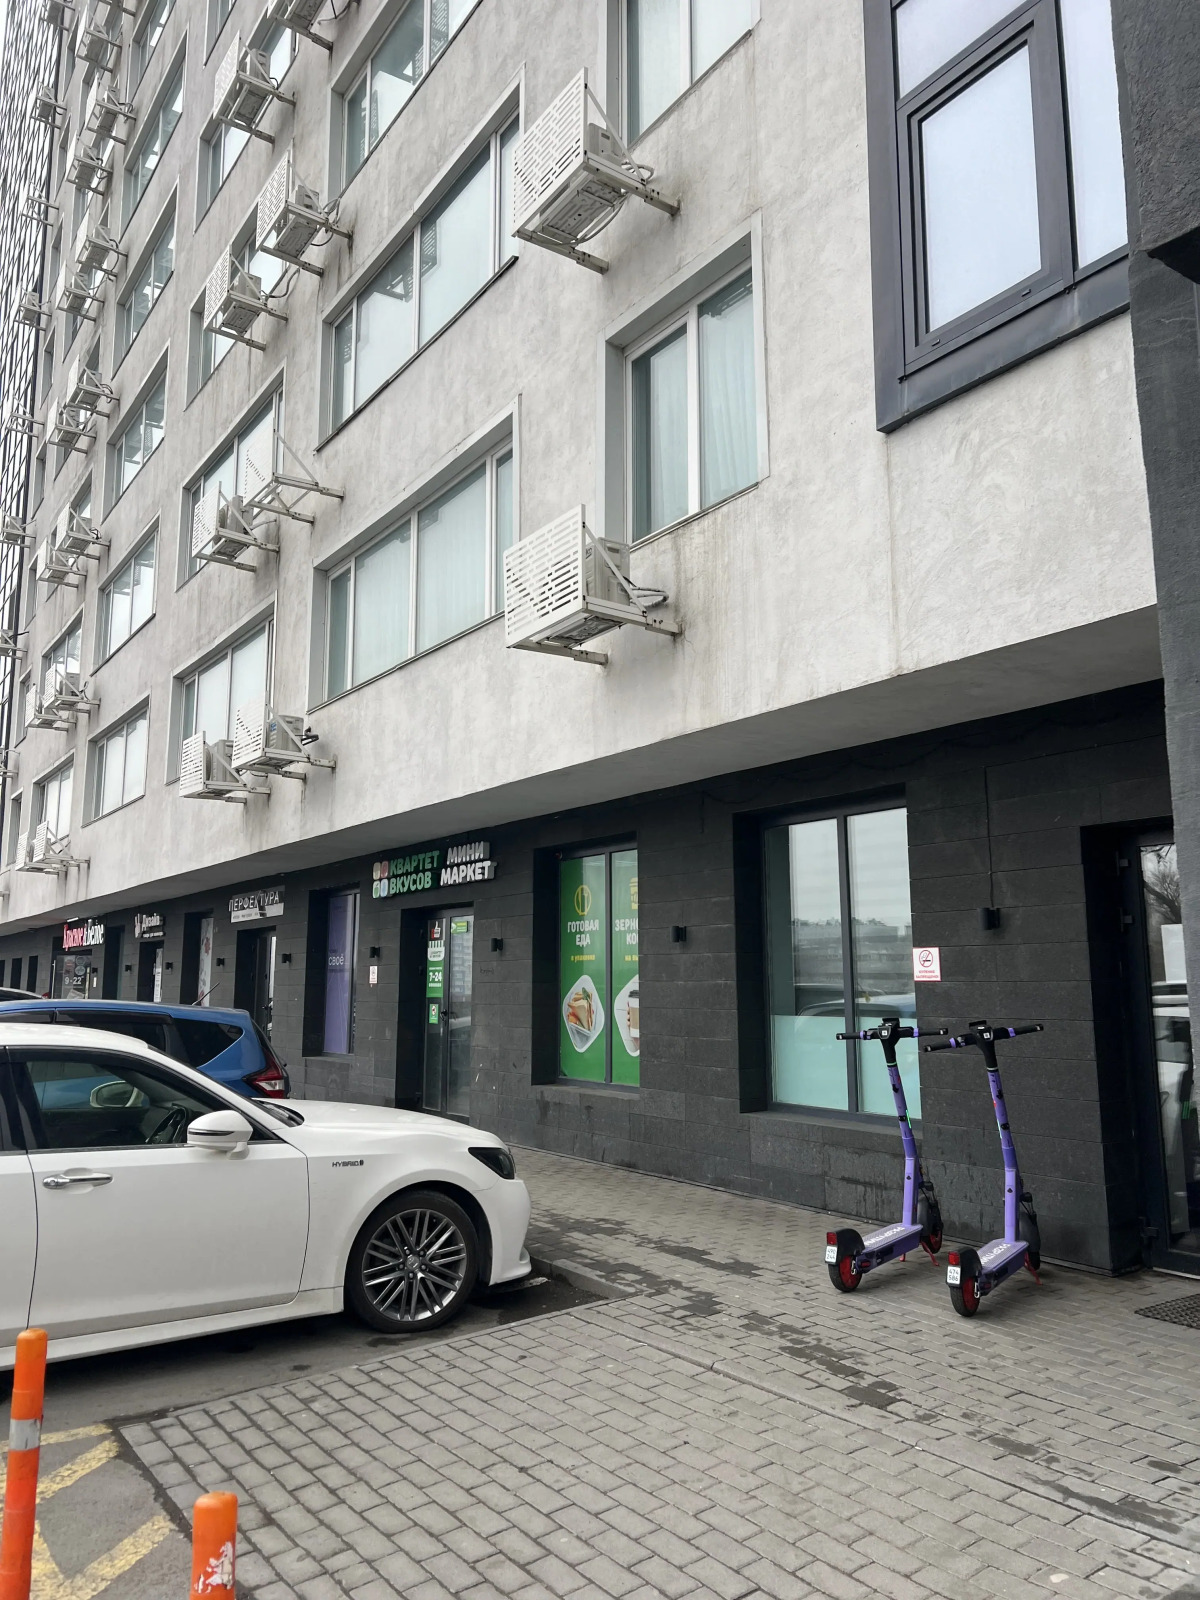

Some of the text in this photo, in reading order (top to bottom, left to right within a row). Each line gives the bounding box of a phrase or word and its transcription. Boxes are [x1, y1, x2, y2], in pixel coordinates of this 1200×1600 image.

[390, 850, 440, 875] КВАРТЕТ
[446, 841, 484, 865] МИНИ
[389, 871, 432, 895] ВКУСОВ
[440, 860, 491, 886] МАРКЕТ
[567, 919, 600, 933] ГОТОВАЯ
[575, 933, 591, 948] ЕДА
[428, 971, 443, 982] 7-24
